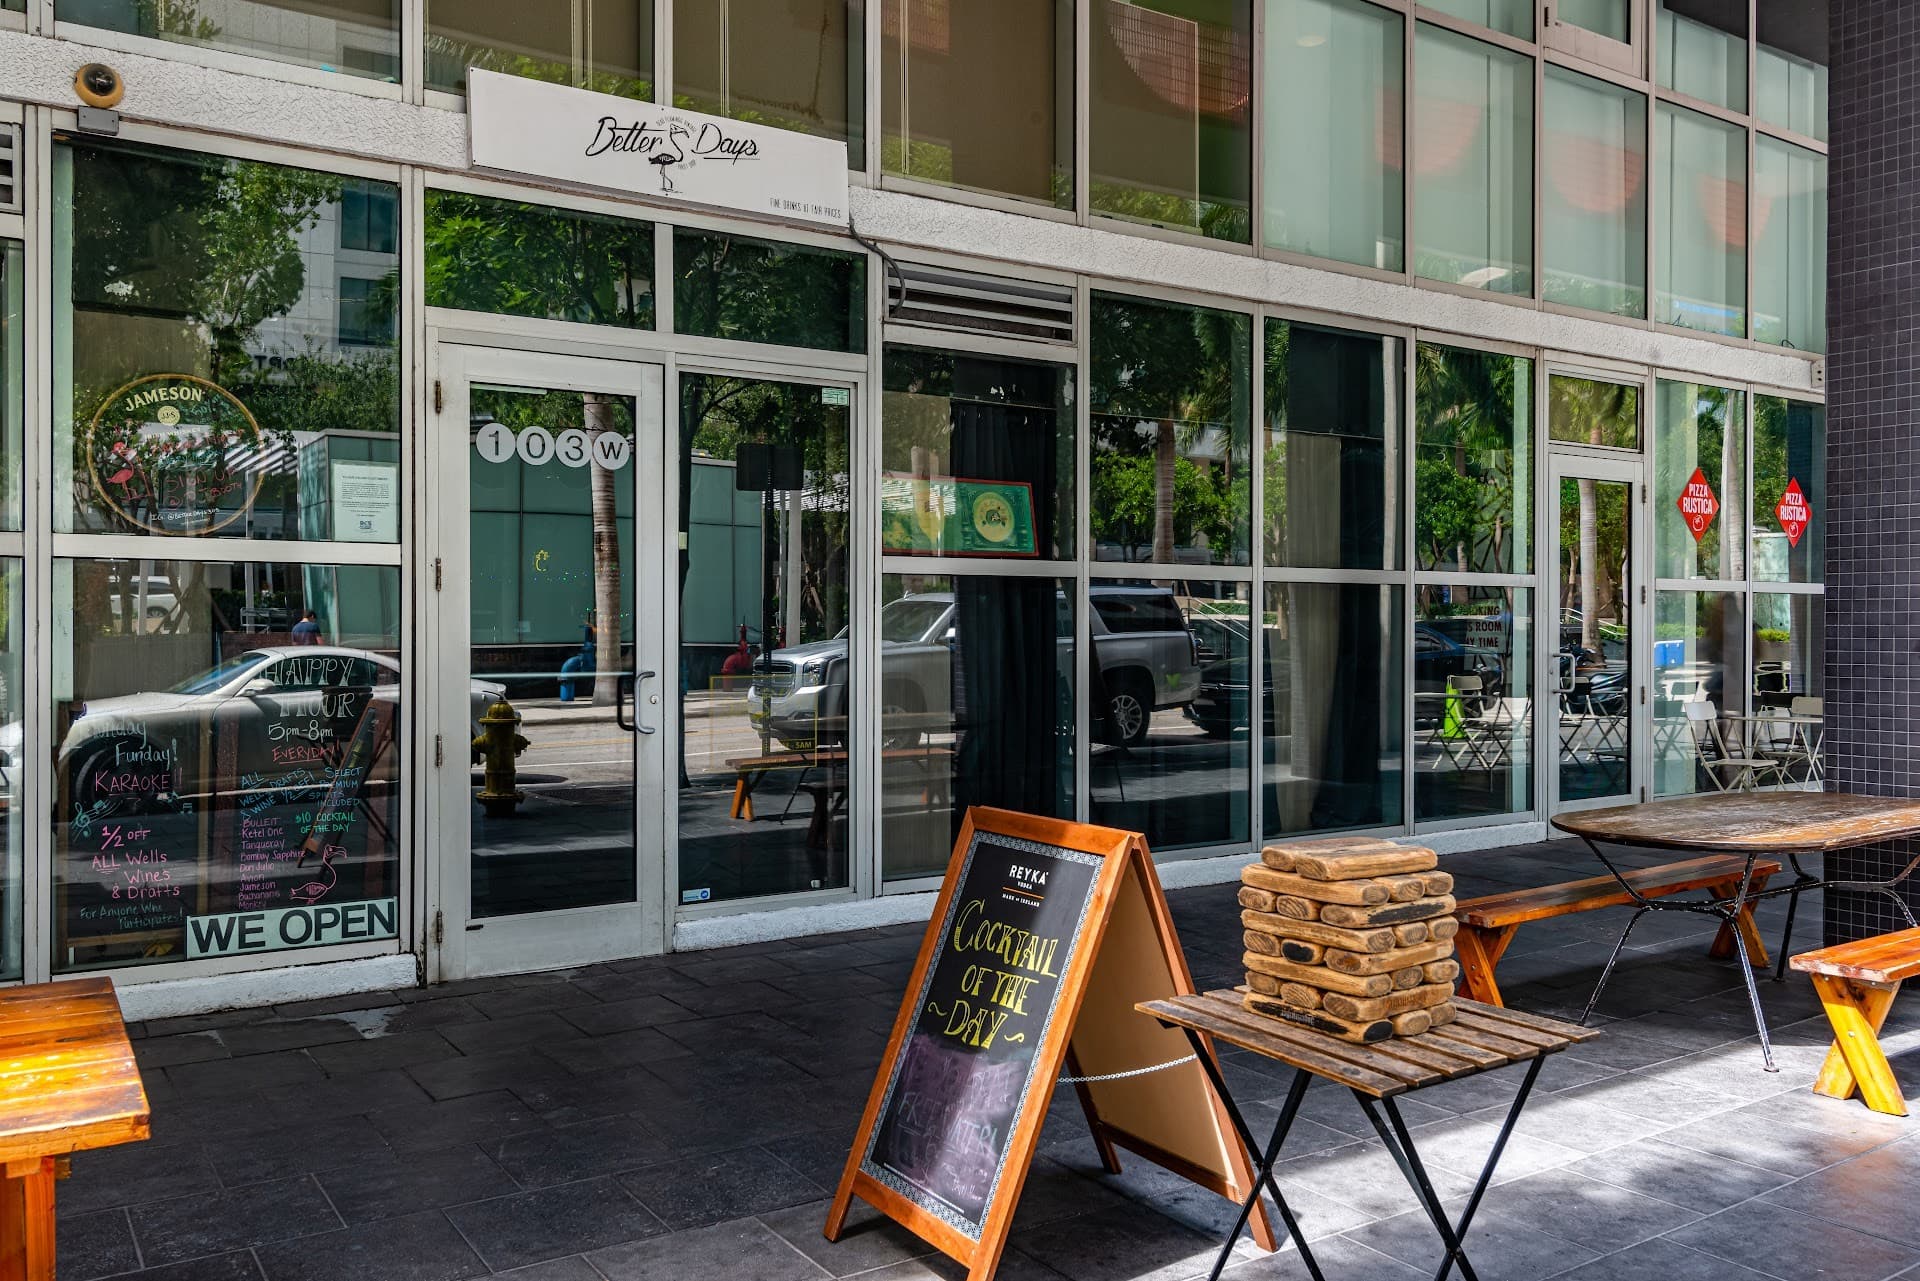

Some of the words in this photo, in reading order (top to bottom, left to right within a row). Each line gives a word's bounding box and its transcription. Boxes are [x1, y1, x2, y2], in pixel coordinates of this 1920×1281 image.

[585, 116, 665, 157] Better
[691, 122, 760, 165] Days
[125, 386, 202, 412] JAMESON
[1688, 483, 1708, 498] PIZZA
[1785, 492, 1803, 506] PIZZA
[1682, 497, 1713, 515] RUSTICA
[1780, 505, 1806, 522] RUSTICA
[1478, 605, 1500, 616] KING
[1475, 621, 1502, 632] ROOM
[1478, 636, 1499, 648] TIME
[258, 658, 355, 686] HAPPY
[279, 692, 355, 718] HOUR
[268, 719, 334, 743] 5pm-8pm
[115, 738, 178, 771] Funday!
[324, 767, 364, 778] SELECT
[250, 795, 276, 814] WINE
[317, 797, 361, 807] INCLUDED
[316, 812, 357, 822] COCKTAIL
[101, 825, 125, 850] 1/2
[127, 829, 151, 840] OFF
[242, 827, 265, 839] Ketel
[268, 827, 284, 836] One
[300, 825, 311, 834] OF
[332, 823, 351, 833] DAY
[91, 853, 120, 869] ALL
[125, 848, 168, 865] Wells
[124, 868, 171, 884] Wines
[190, 913, 266, 954] WE
[279, 901, 396, 945] OPEN
[961, 964, 993, 997] OF
[990, 970, 1040, 1016] THE
[943, 999, 1009, 1050] DAY
